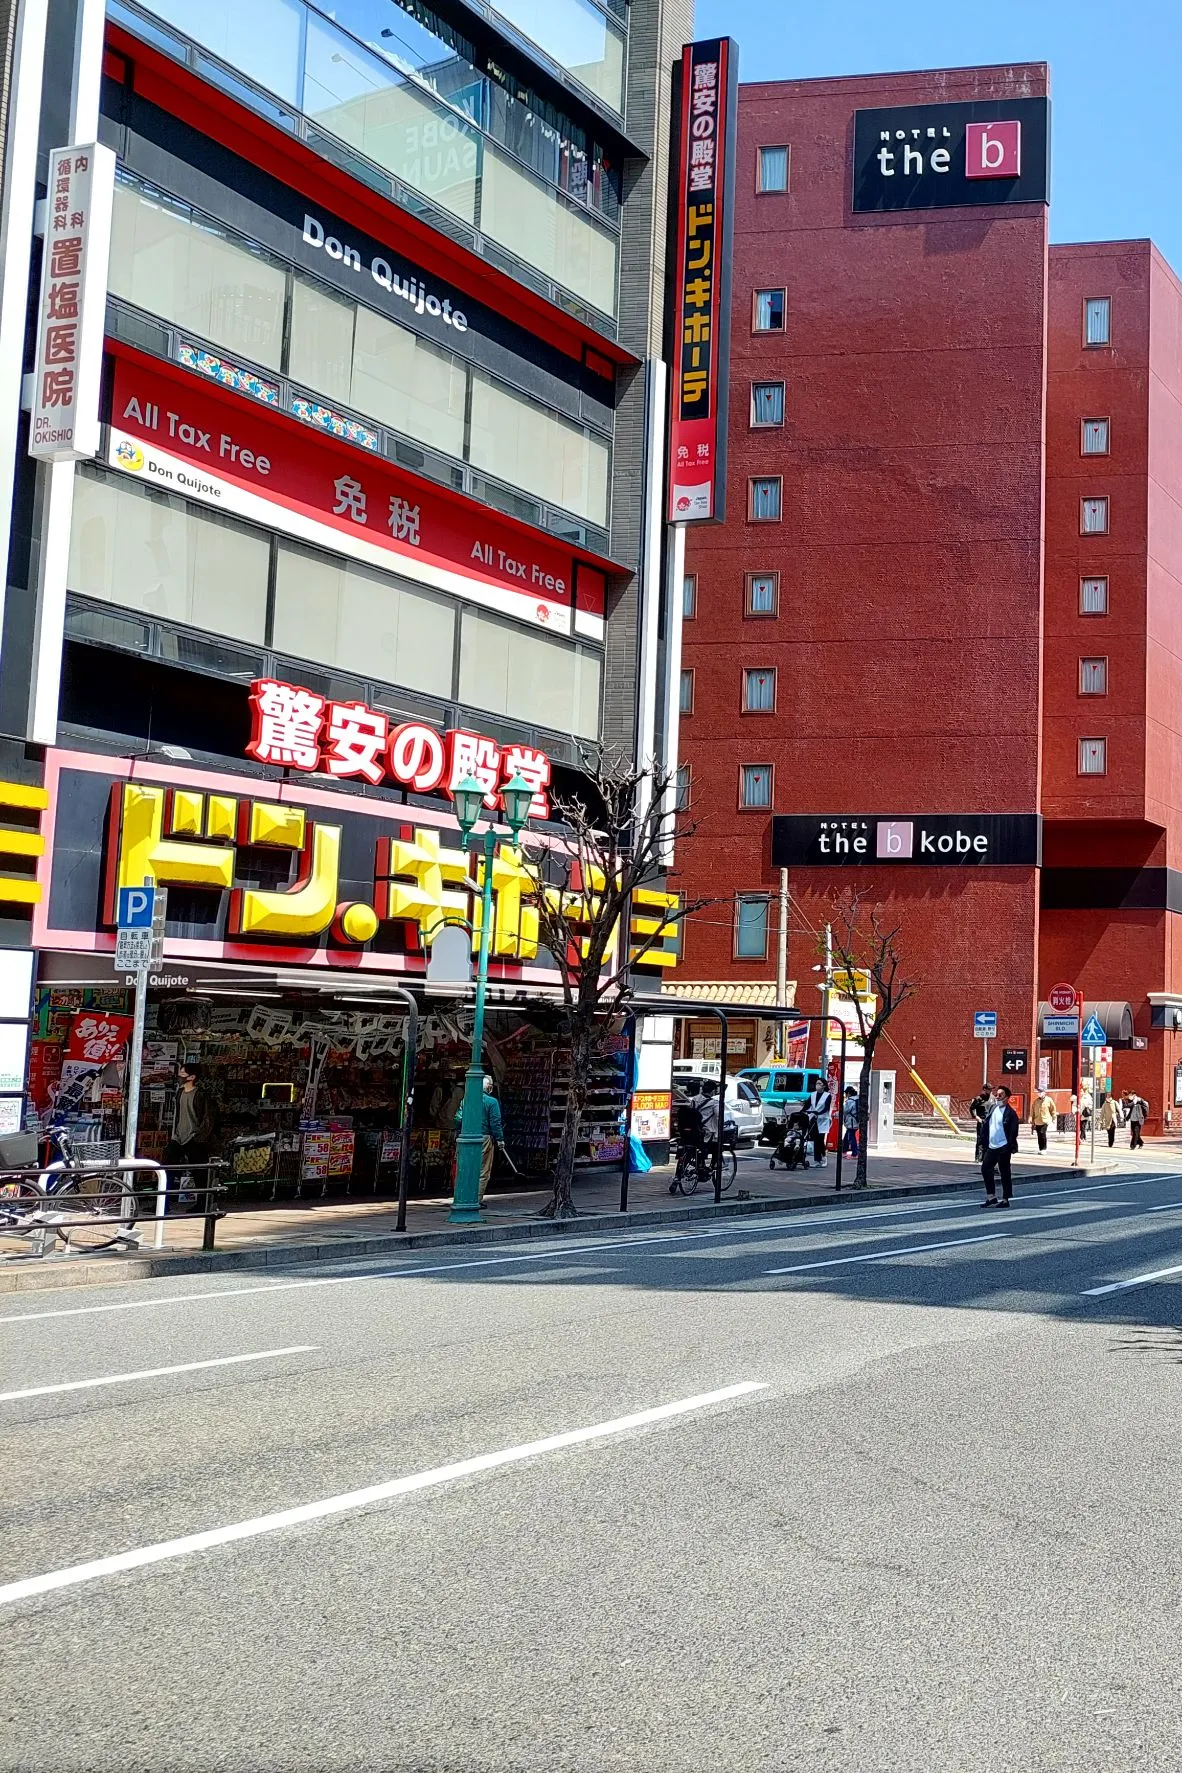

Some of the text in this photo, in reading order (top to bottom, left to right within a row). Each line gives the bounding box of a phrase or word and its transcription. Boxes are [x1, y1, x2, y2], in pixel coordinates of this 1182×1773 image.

[689, 61, 717, 192] 驚安の殿堂
[880, 126, 950, 141] HOTEL
[877, 144, 950, 176] the
[53, 157, 72, 232] 循環器科
[302, 213, 469, 332] Don Quijote
[41, 236, 84, 410] 置塩医院
[35, 427, 73, 444] OKISHIO
[36, 417, 52, 430] DR.
[123, 396, 271, 475] All Tax Free
[148, 461, 221, 498] Don Quijote
[470, 541, 566, 594] All Tax Free
[250, 680, 549, 819] 驚安の殿堂
[818, 832, 867, 853] the
[920, 830, 988, 853] kobe
[127, 891, 148, 923] P
[116, 959, 149, 968] ここまで
[125, 975, 189, 987] Do Quijote
[1052, 996, 1072, 1005] 消火栓
[1015, 1060, 1024, 1070] P
[317, 1143, 329, 1153] 58
[315, 1165, 328, 1175] 58
